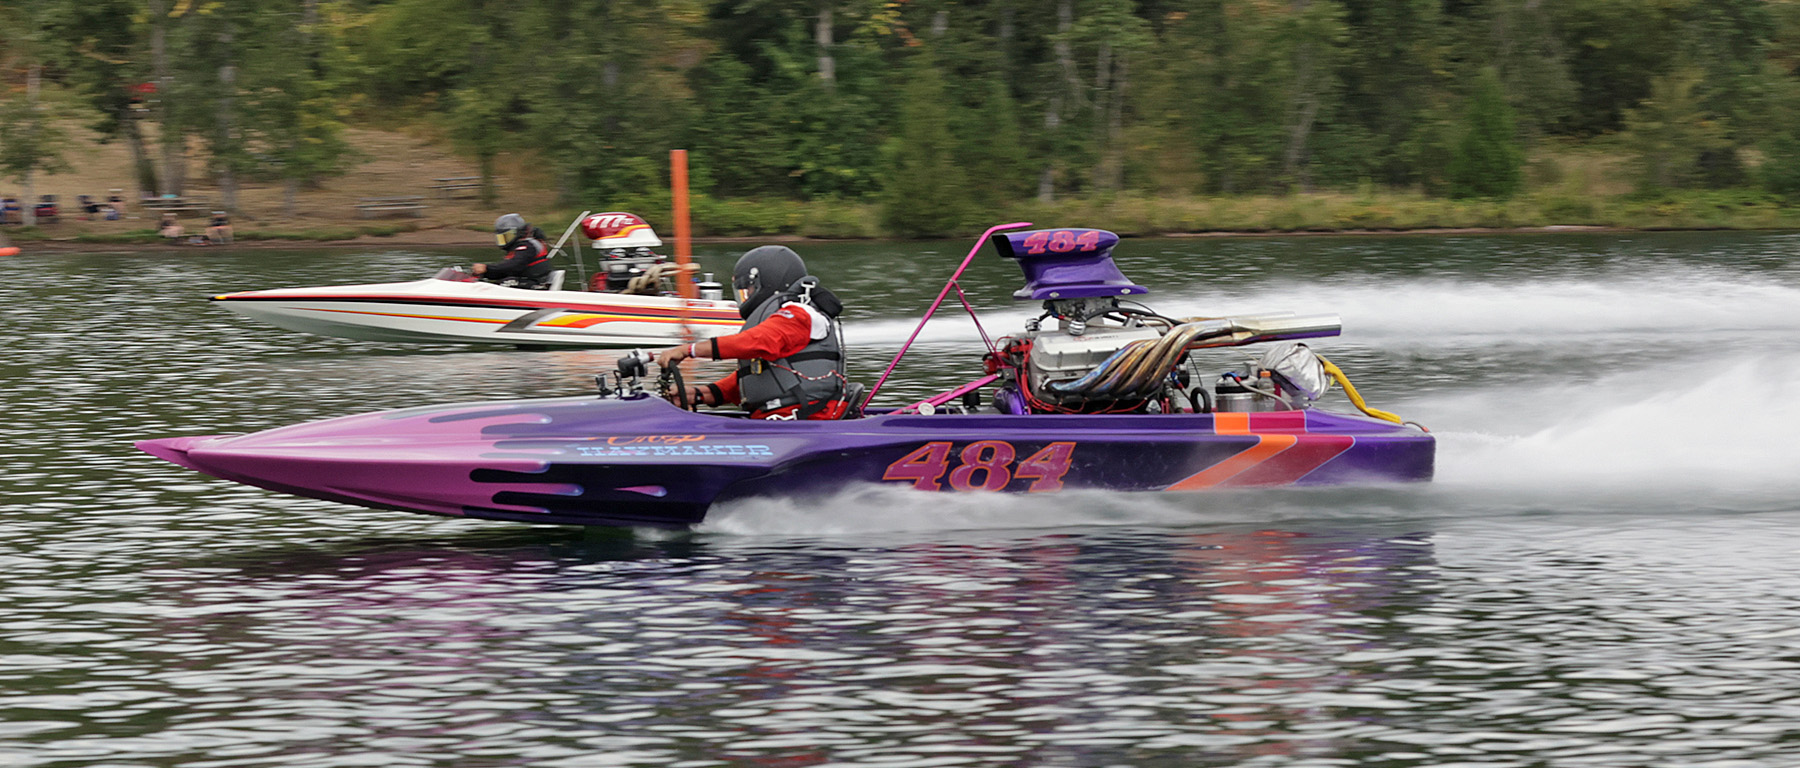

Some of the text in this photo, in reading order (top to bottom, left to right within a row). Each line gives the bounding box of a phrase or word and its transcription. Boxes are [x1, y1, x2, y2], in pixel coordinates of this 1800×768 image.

[1023, 231, 1100, 254] 484
[577, 445, 773, 456] HAYMAKER
[882, 440, 1077, 492] 484
